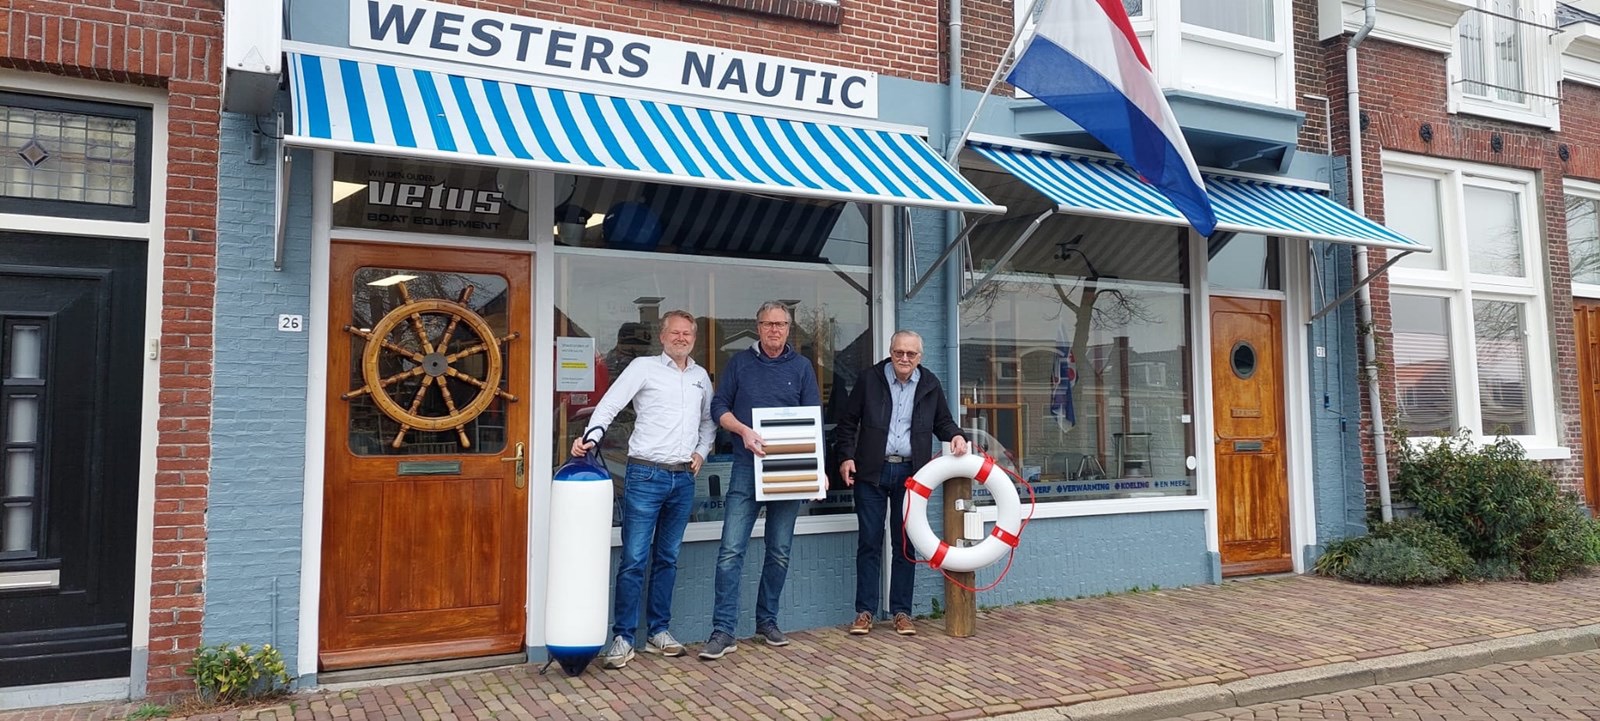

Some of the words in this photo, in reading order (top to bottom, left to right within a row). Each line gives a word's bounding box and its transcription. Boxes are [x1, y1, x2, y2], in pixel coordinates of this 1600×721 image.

[367, 0, 651, 79] WESTERS
[680, 51, 868, 109] NAUTIC
[387, 171, 405, 180] DEN
[406, 172, 436, 182] OUDEN
[367, 178, 503, 215] vetus
[367, 212, 408, 224] BOAT
[413, 216, 500, 230] EQUIPMENT
[282, 317, 299, 329] 26
[1033, 485, 1052, 494] VERF
[1063, 483, 1110, 493] VERWARMING
[1120, 481, 1150, 490] KOELING
